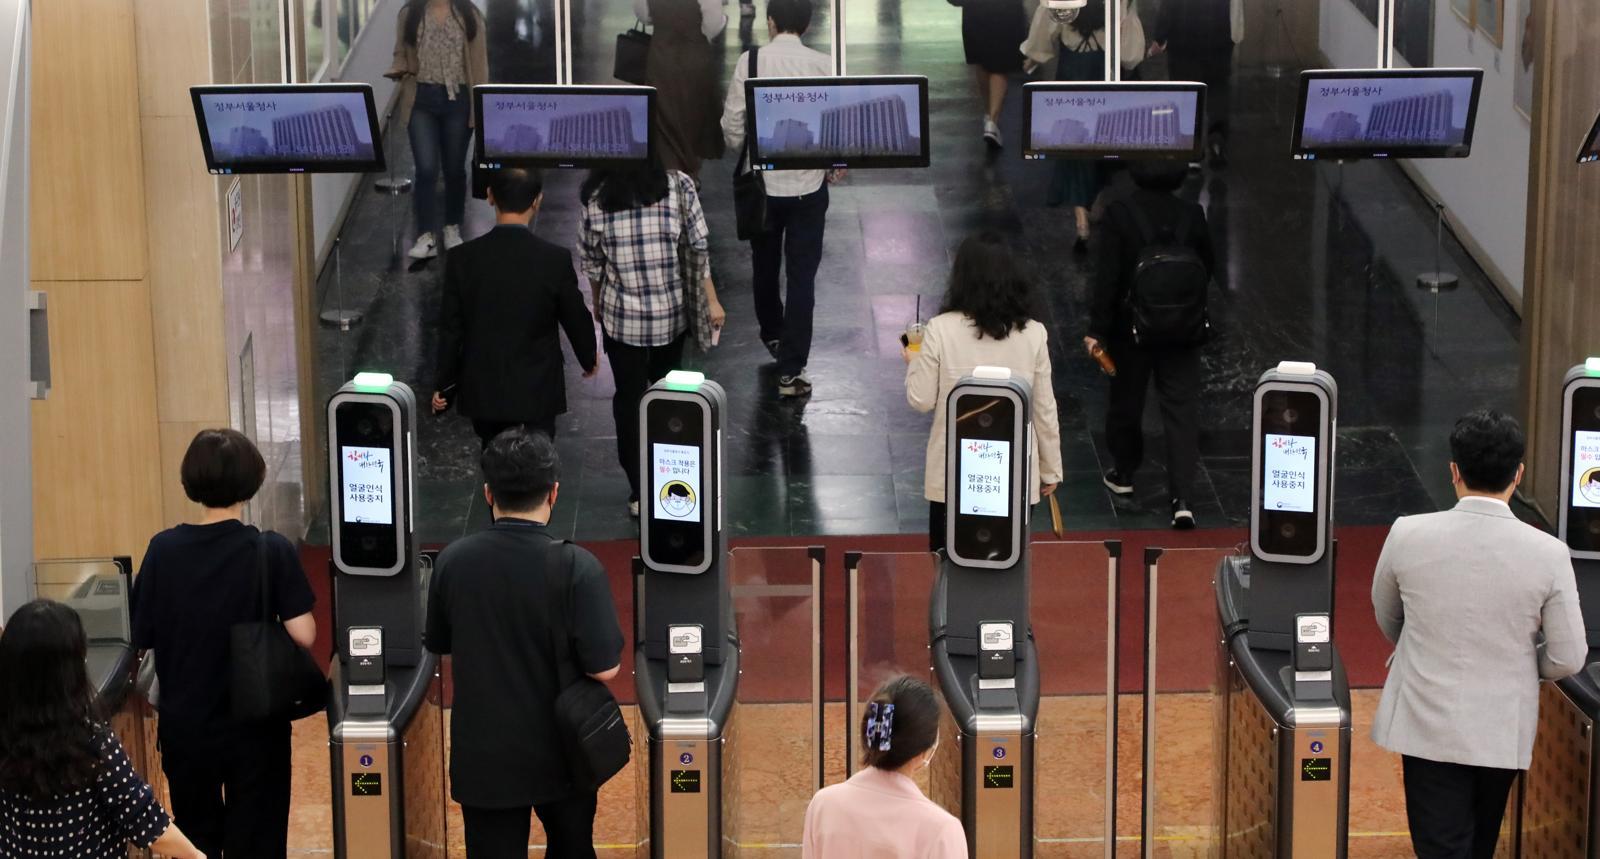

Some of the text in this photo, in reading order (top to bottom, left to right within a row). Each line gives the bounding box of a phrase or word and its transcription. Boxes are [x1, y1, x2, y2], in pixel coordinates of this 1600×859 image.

[1320, 86, 1384, 97] 정부서울청사
[762, 91, 829, 104] 정부서울청사
[214, 101, 277, 112] 정부서울청사
[496, 101, 558, 111] 정부서울청사
[967, 473, 1000, 484] 얼굴인식
[1272, 469, 1305, 480] 얼굴인식
[349, 483, 383, 493] 얼굴인식
[967, 484, 1000, 493] 사용중지
[1272, 480, 1305, 490] 사용중지
[349, 494, 383, 503] 사용중지
